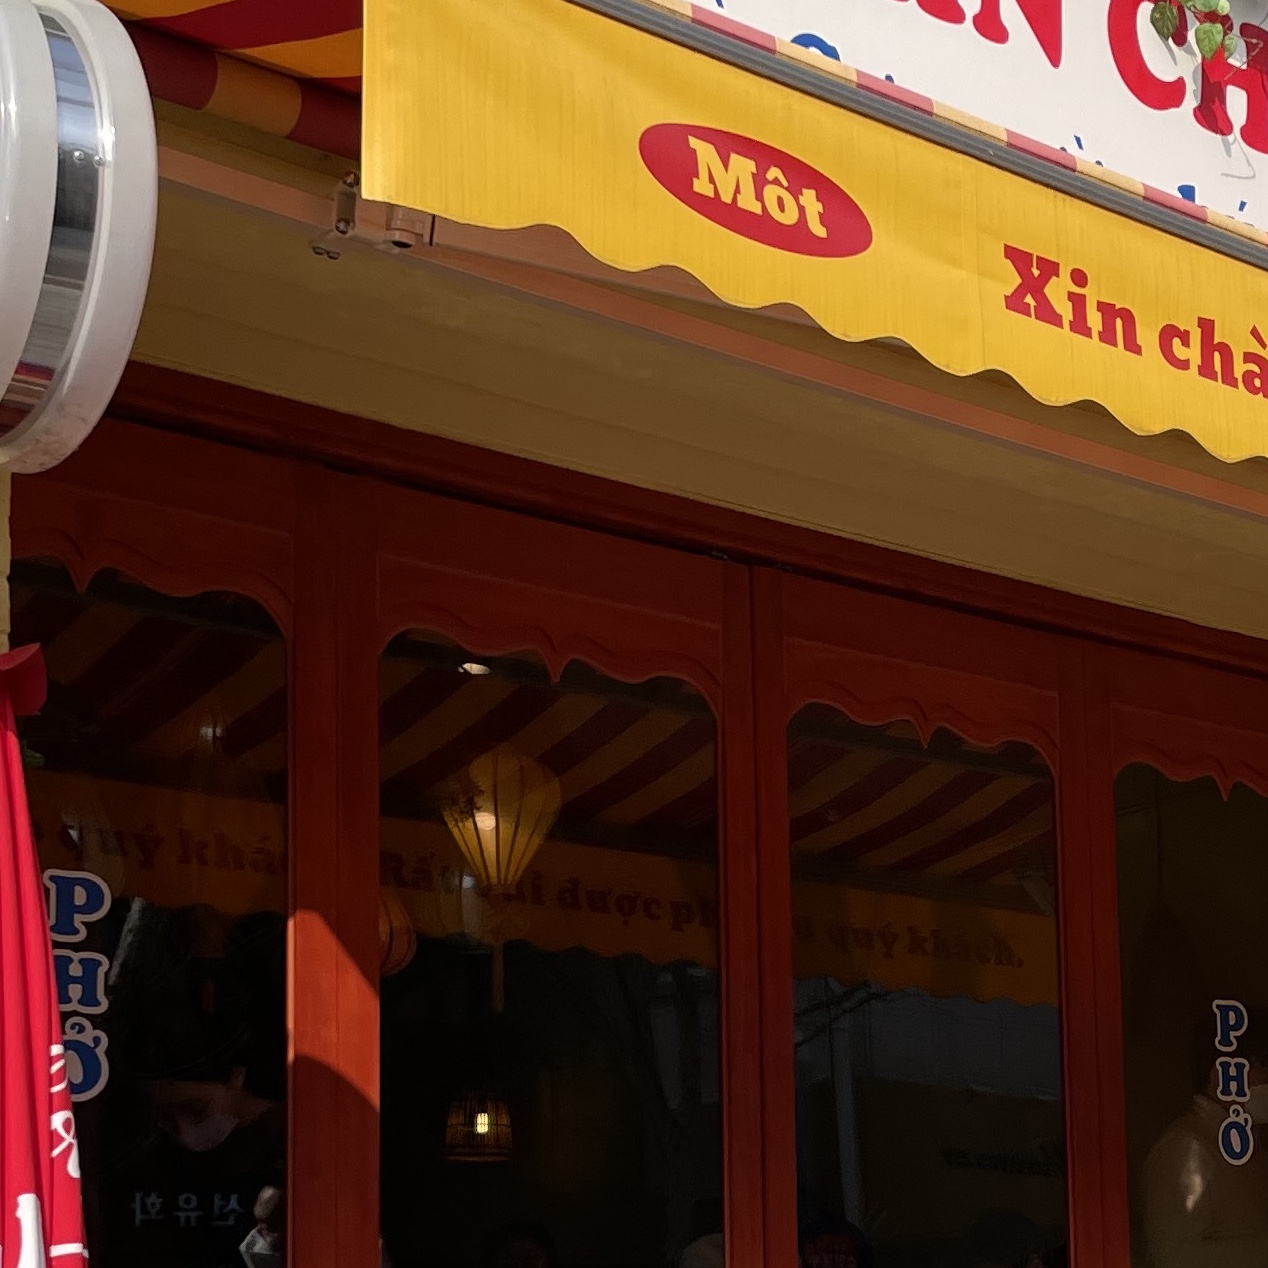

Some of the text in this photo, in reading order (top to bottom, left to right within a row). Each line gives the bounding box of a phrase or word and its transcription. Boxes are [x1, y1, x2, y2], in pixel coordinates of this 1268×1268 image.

[687, 134, 828, 239] Môt
[1003, 243, 1143, 357] Xin
[1213, 1000, 1254, 1165] PHỞ
